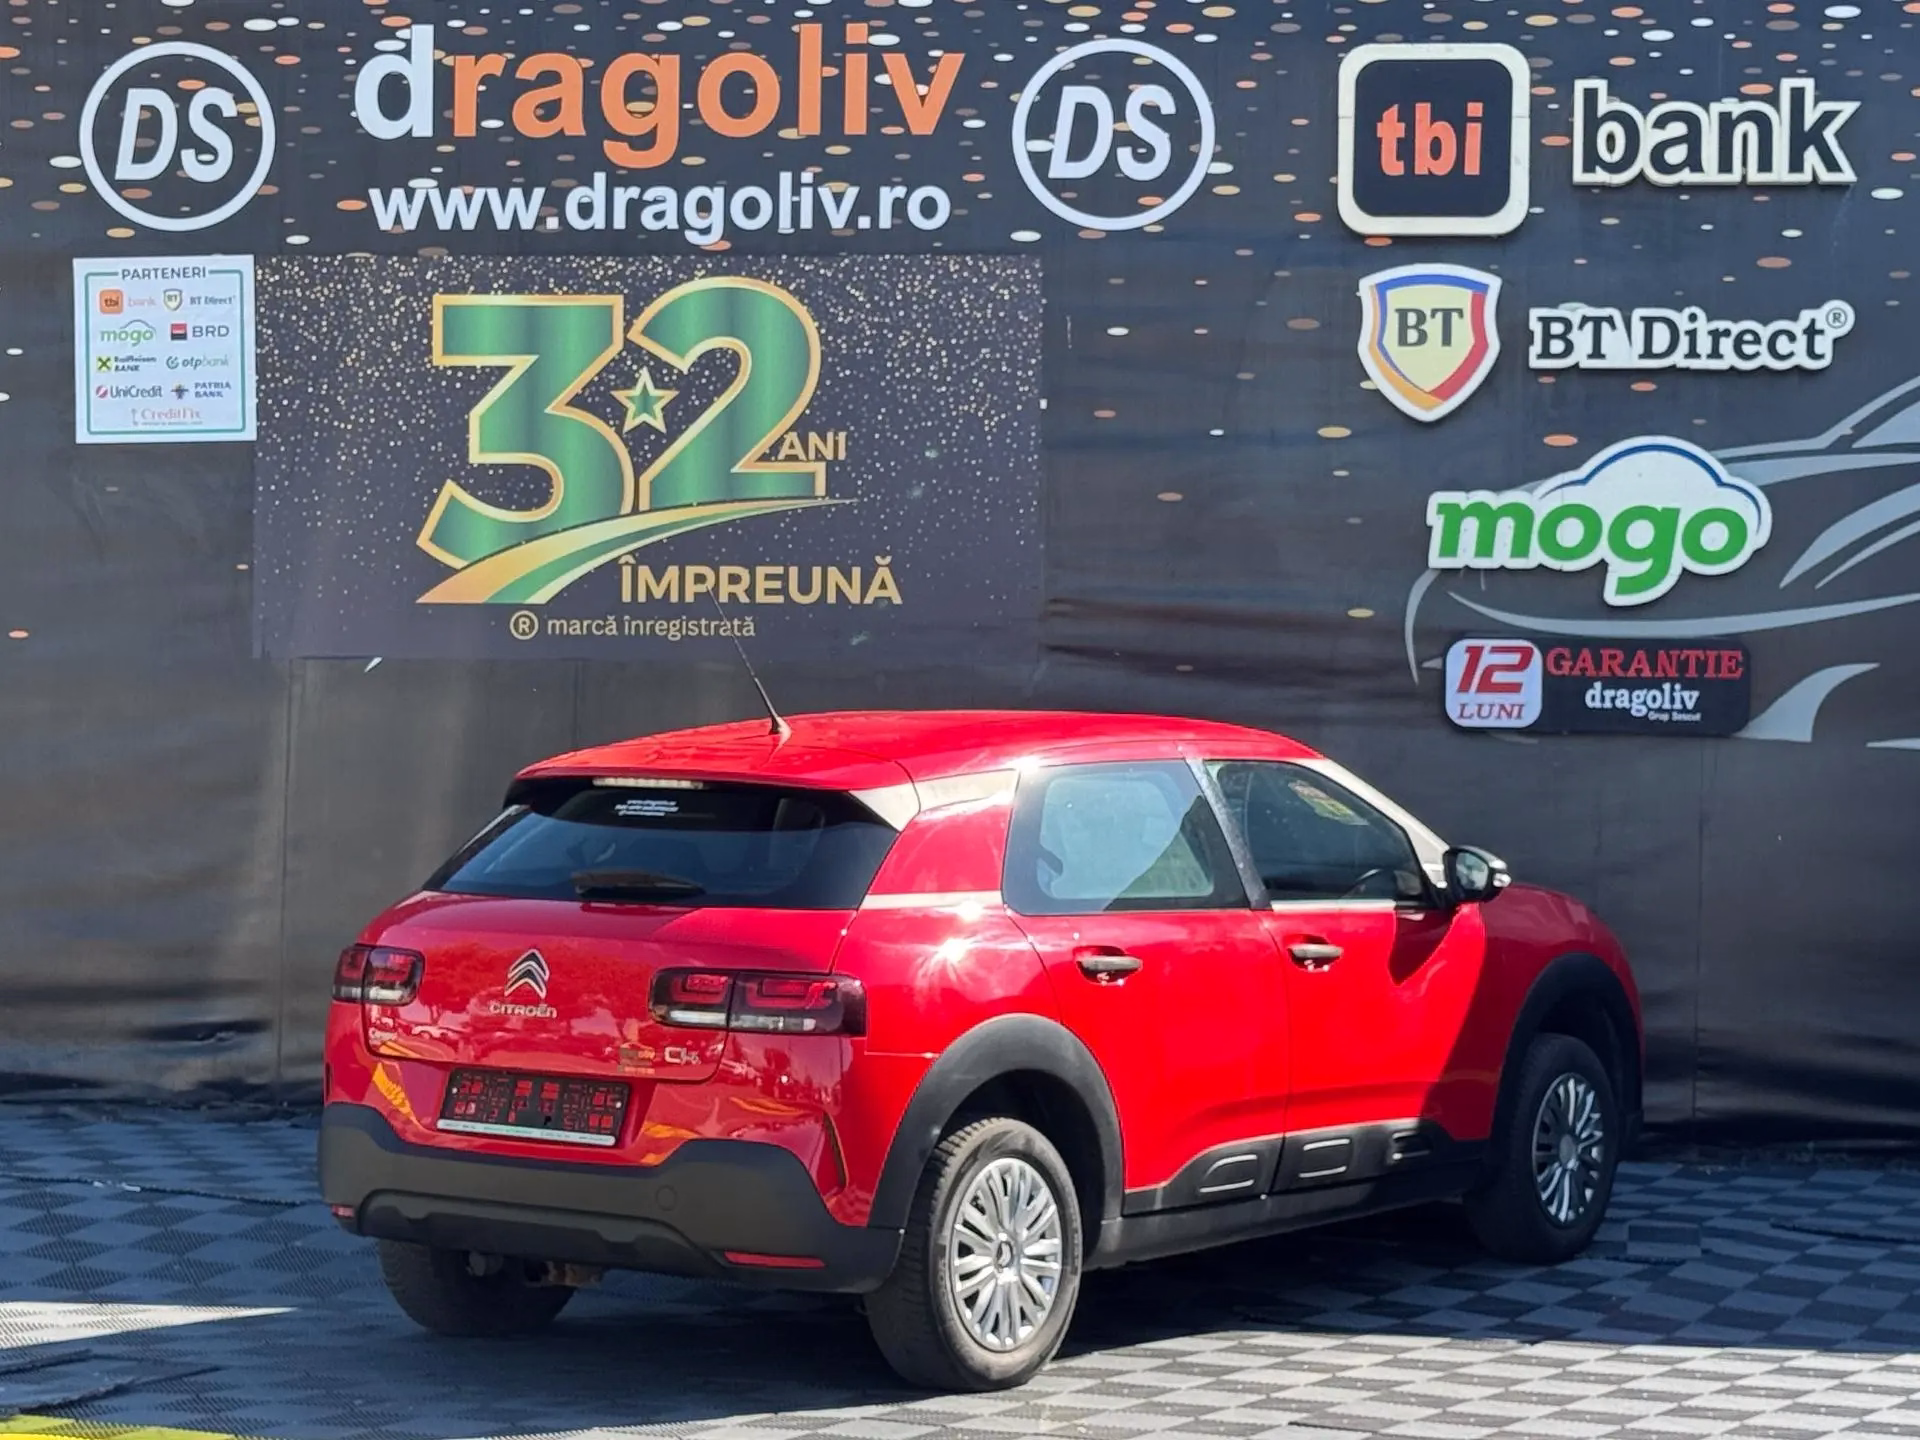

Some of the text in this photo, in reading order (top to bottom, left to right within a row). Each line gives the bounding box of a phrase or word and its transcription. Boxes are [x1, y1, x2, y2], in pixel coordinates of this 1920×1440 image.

[354, 23, 966, 168] dragoliv
[115, 87, 238, 183] DS
[1048, 84, 1176, 181] DS
[1376, 82, 1856, 182] tbi bank
[368, 171, 951, 246] www.dragoliv.ro
[121, 266, 207, 281] PARTENERI
[104, 297, 120, 308] tbi
[100, 328, 154, 347] mogo
[192, 324, 230, 338] BRD
[1395, 308, 1464, 347] BT
[1536, 314, 1617, 360] BT
[110, 384, 163, 399] UniCredit
[194, 381, 232, 390] PATRIA
[194, 390, 224, 398] BANK
[416, 275, 827, 570] 32
[777, 431, 848, 461] ANI
[1436, 501, 1748, 597] mogo
[618, 554, 903, 605] ÎMPREUNĂ
[547, 614, 619, 637] marcă
[624, 612, 756, 641] înregistrată
[1457, 645, 1745, 693] 12 GARANTIE
[1457, 703, 1525, 721] LUNI
[1585, 681, 1700, 718] dragoliv
